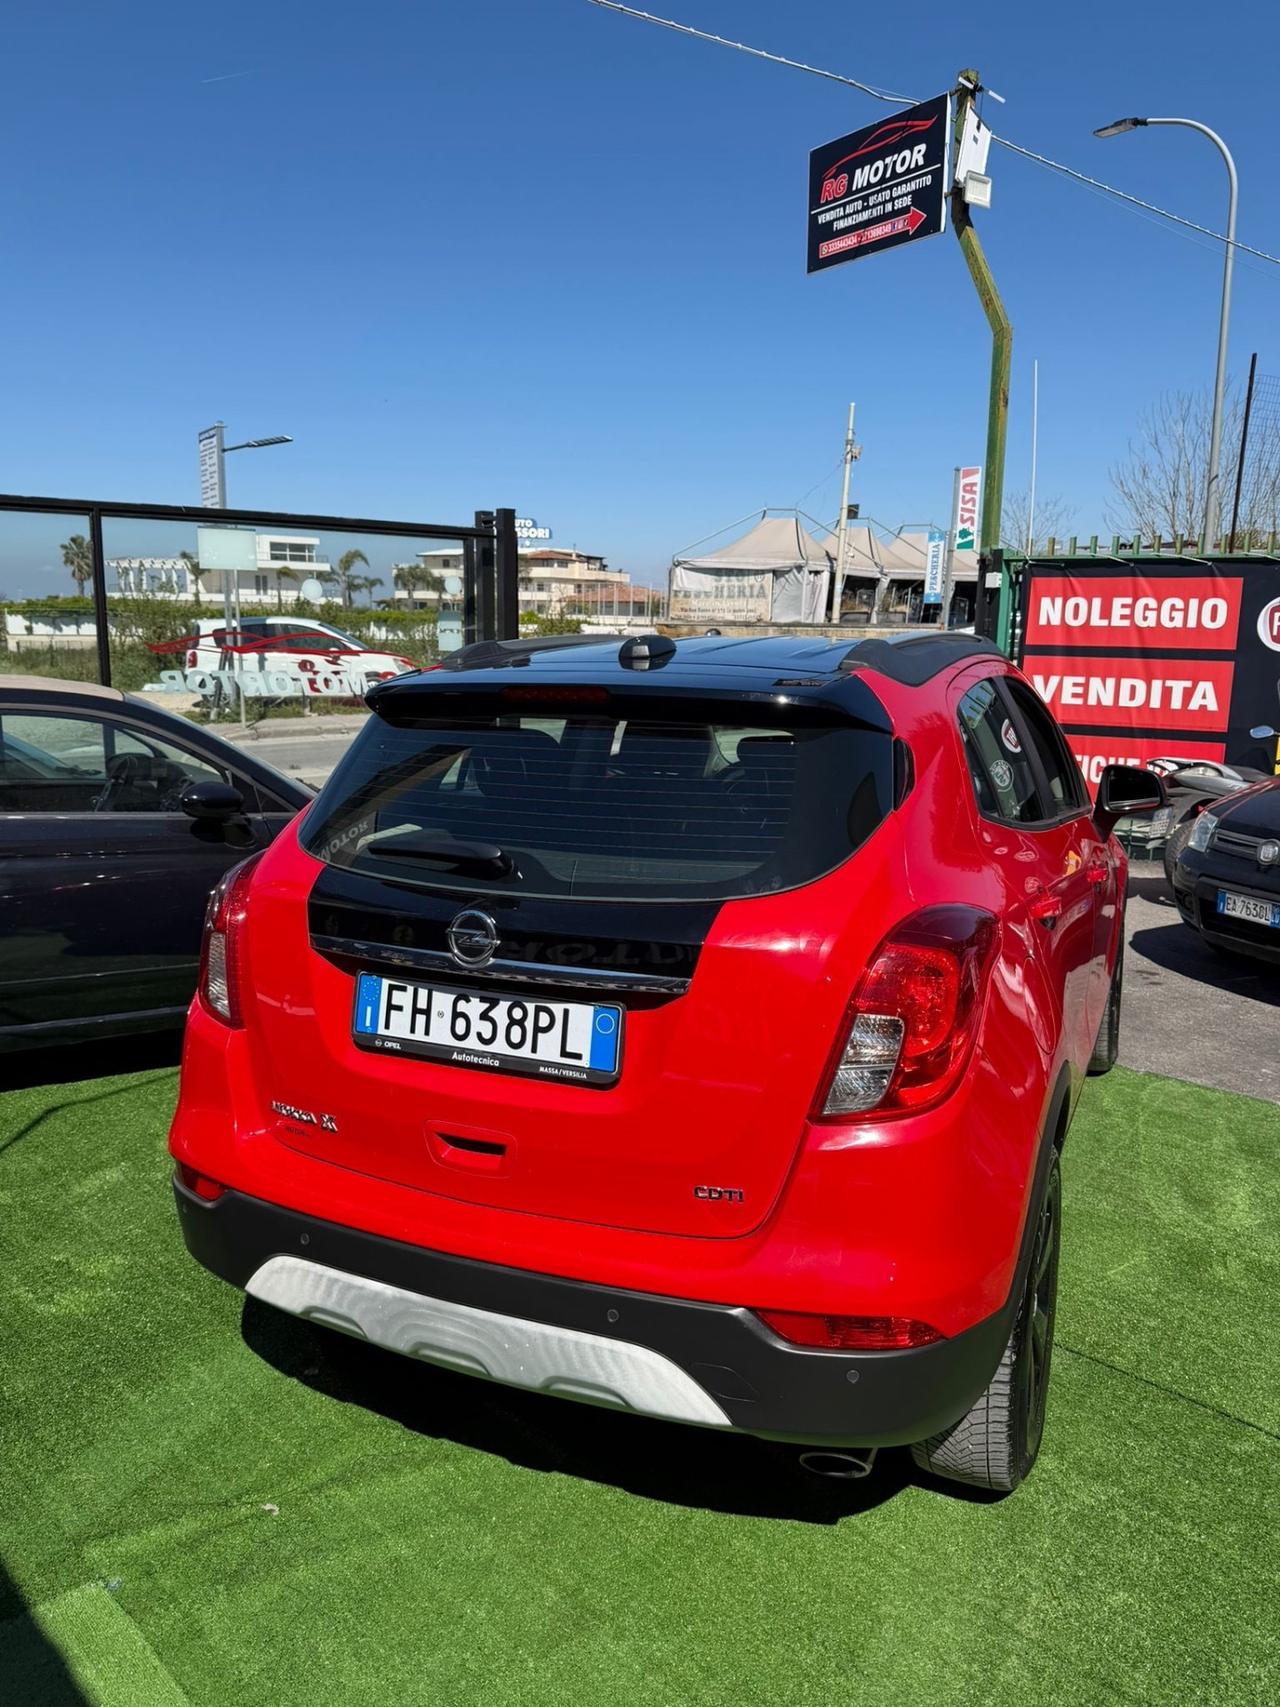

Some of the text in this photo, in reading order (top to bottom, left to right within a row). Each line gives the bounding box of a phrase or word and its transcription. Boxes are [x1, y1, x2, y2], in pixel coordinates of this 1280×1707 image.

[820, 143, 927, 204] RG MOTOR
[818, 206, 844, 224] VENDITA
[845, 200, 863, 215] AUTO
[869, 190, 891, 206] USATO
[892, 175, 932, 197] GARANTITO
[833, 195, 912, 231] FINANZIAMENTI IN SEDE
[960, 482, 977, 527] SISA
[929, 543, 941, 591] PESCHERIA
[1038, 596, 1228, 629] NOLEGGIO
[1032, 674, 1219, 712] VENDITA
[1226, 896, 1237, 912] EA
[384, 982, 434, 1037] FH
[450, 993, 584, 1061] 638PL
[384, 1040, 402, 1050] OPEL
[452, 1051, 500, 1067] Autotecnica
[539, 1065, 587, 1079] MASSA/VERSILIA
[694, 1185, 744, 1202] CDTI
